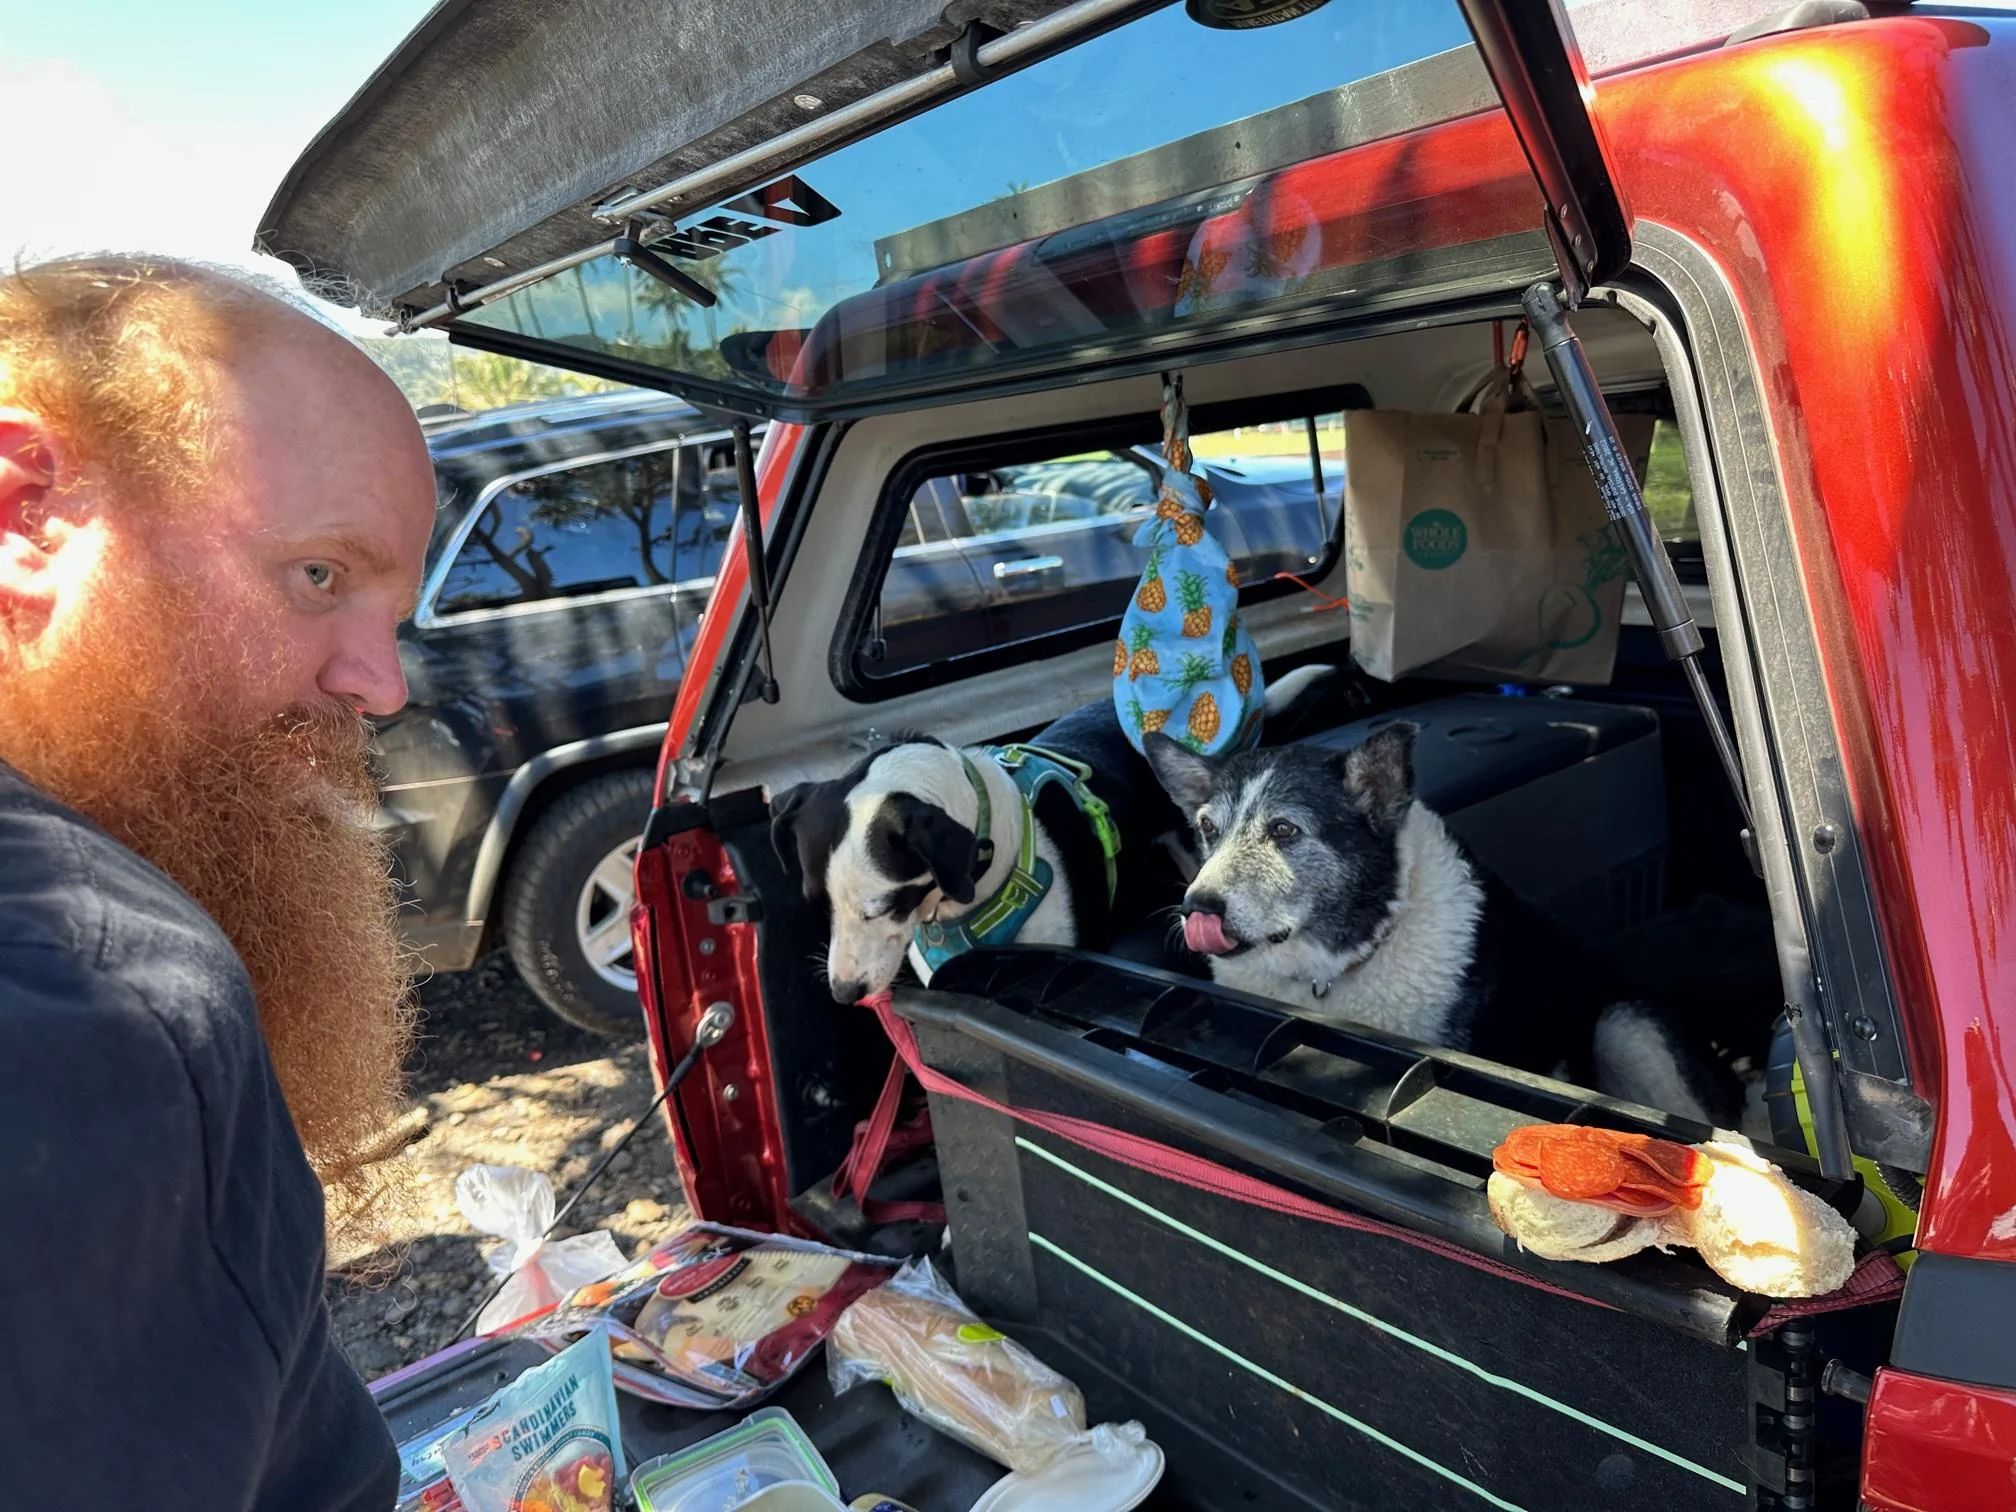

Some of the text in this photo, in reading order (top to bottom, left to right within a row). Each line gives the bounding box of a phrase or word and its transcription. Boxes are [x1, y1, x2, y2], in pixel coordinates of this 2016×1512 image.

[1410, 526, 1461, 539] WHOLE
[1412, 539, 1459, 551] FOODS
[493, 1374, 579, 1450] SCANDINAVIAN
[512, 1400, 577, 1461] SWIMMERS
